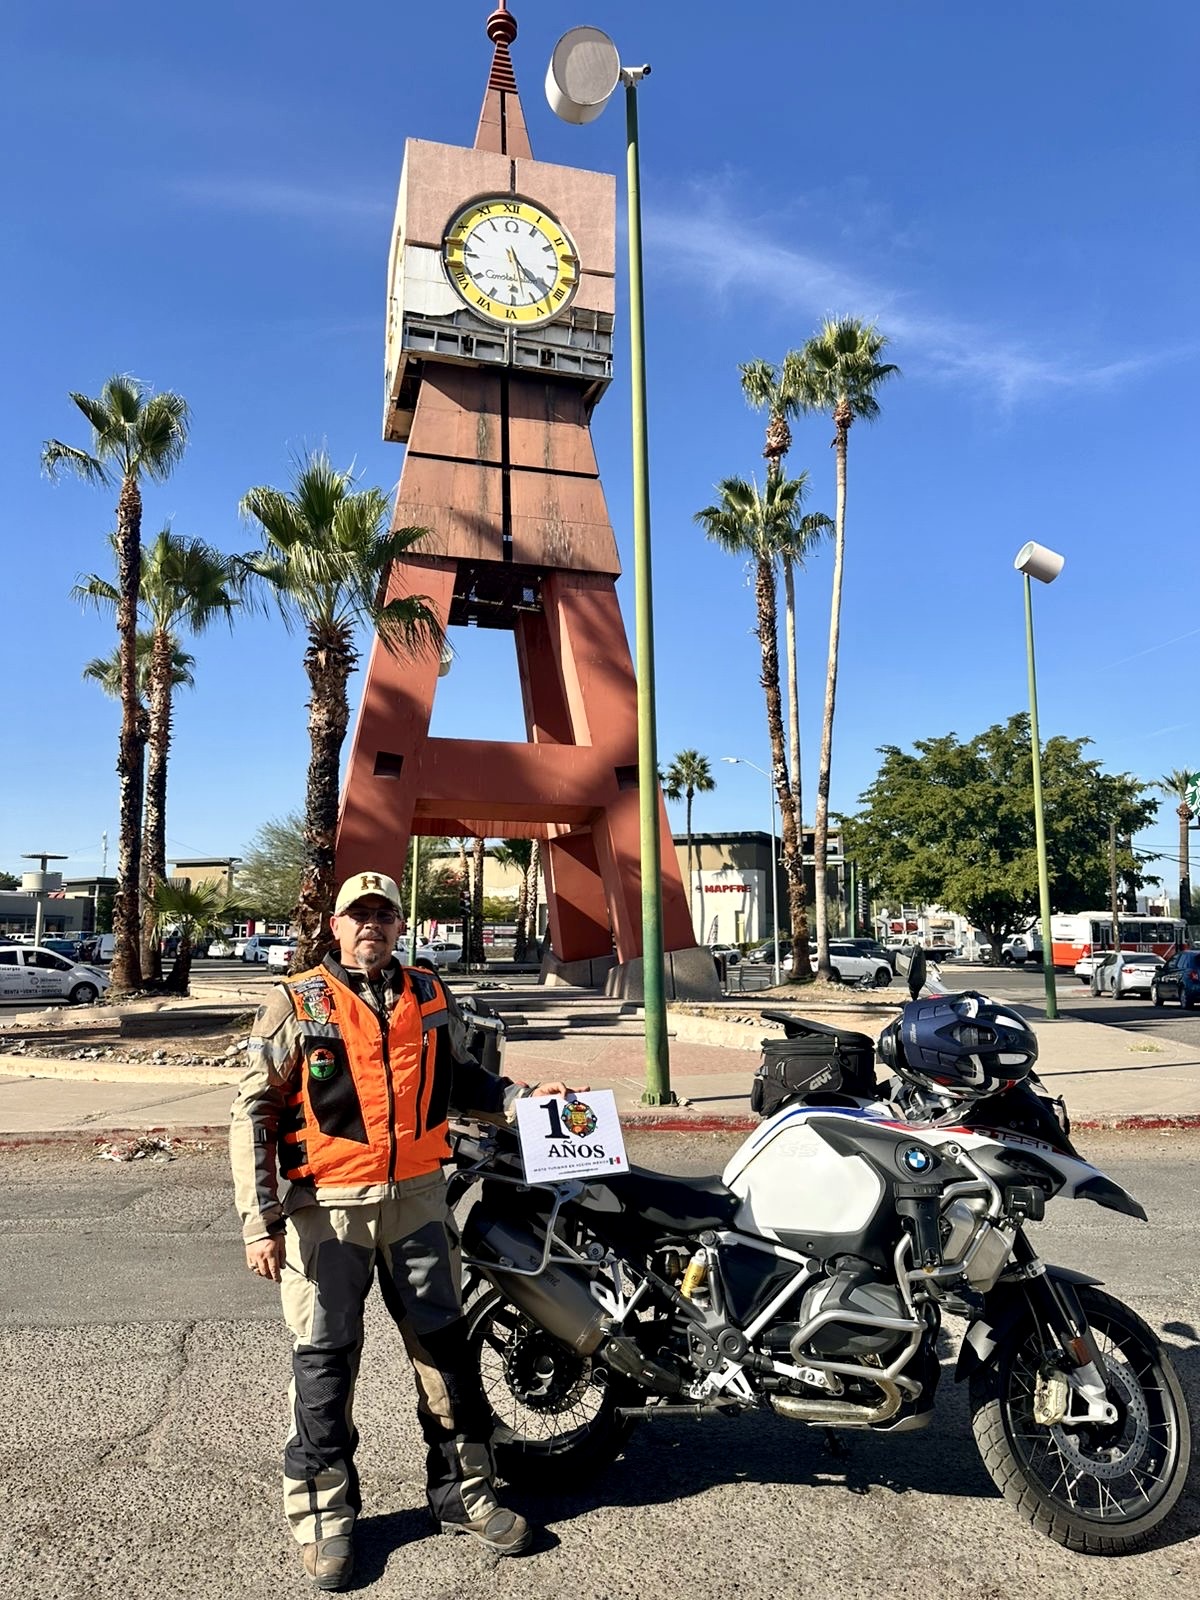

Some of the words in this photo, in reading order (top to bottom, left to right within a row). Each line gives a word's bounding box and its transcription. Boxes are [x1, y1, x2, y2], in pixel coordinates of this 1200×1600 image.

[477, 206, 491, 216] XI
[504, 204, 520, 214] XII
[361, 876, 384, 890] H
[704, 885, 752, 893] MAPFRE
[810, 1070, 832, 1090] GIVI
[994, 1131, 1053, 1152] 1250
[548, 1140, 605, 1158] AÑOS
